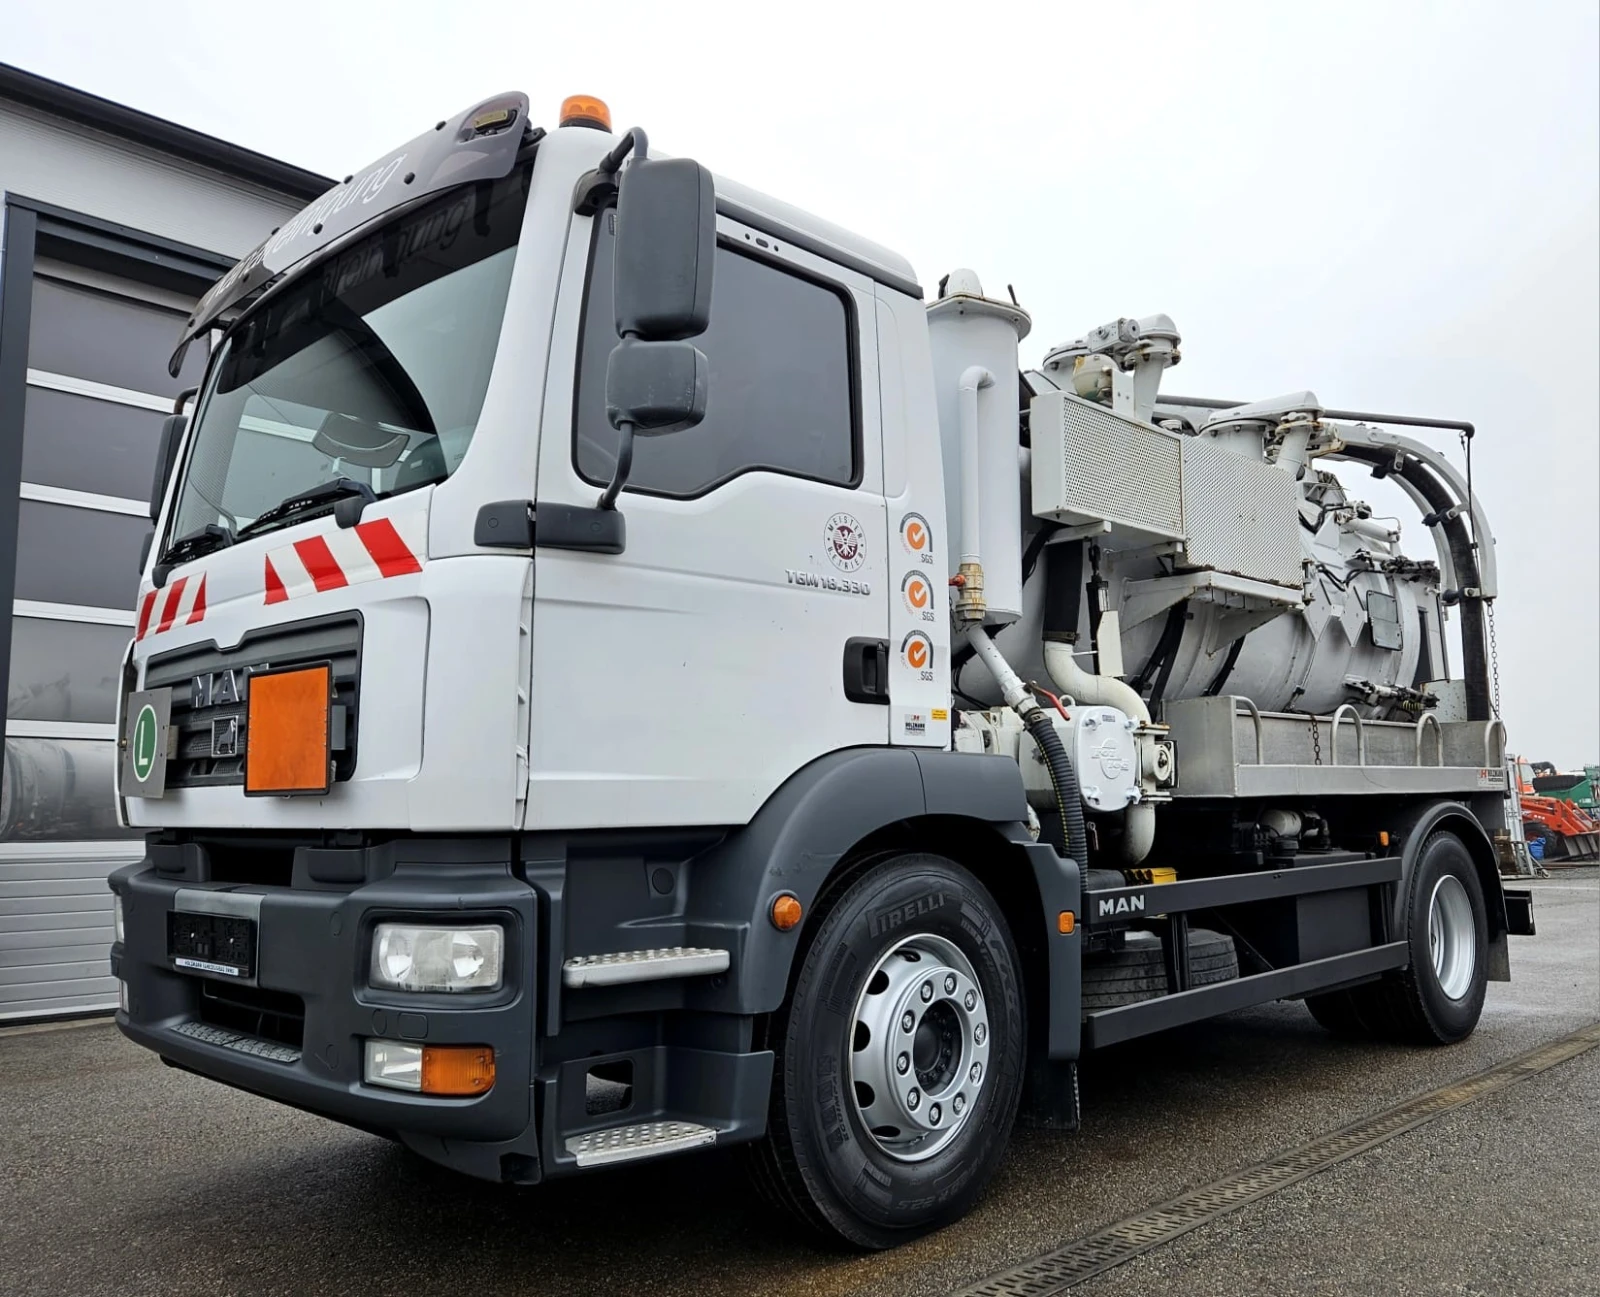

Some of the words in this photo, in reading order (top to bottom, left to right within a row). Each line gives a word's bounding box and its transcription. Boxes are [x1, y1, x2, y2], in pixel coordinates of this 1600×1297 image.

[827, 515, 863, 539] MEISTER
[920, 553, 934, 565] SGS
[921, 611, 935, 622] SGS
[920, 671, 934, 682] SGS
[138, 720, 149, 766] L
[865, 888, 946, 939] PIRELLI
[1099, 895, 1145, 917] MAN
